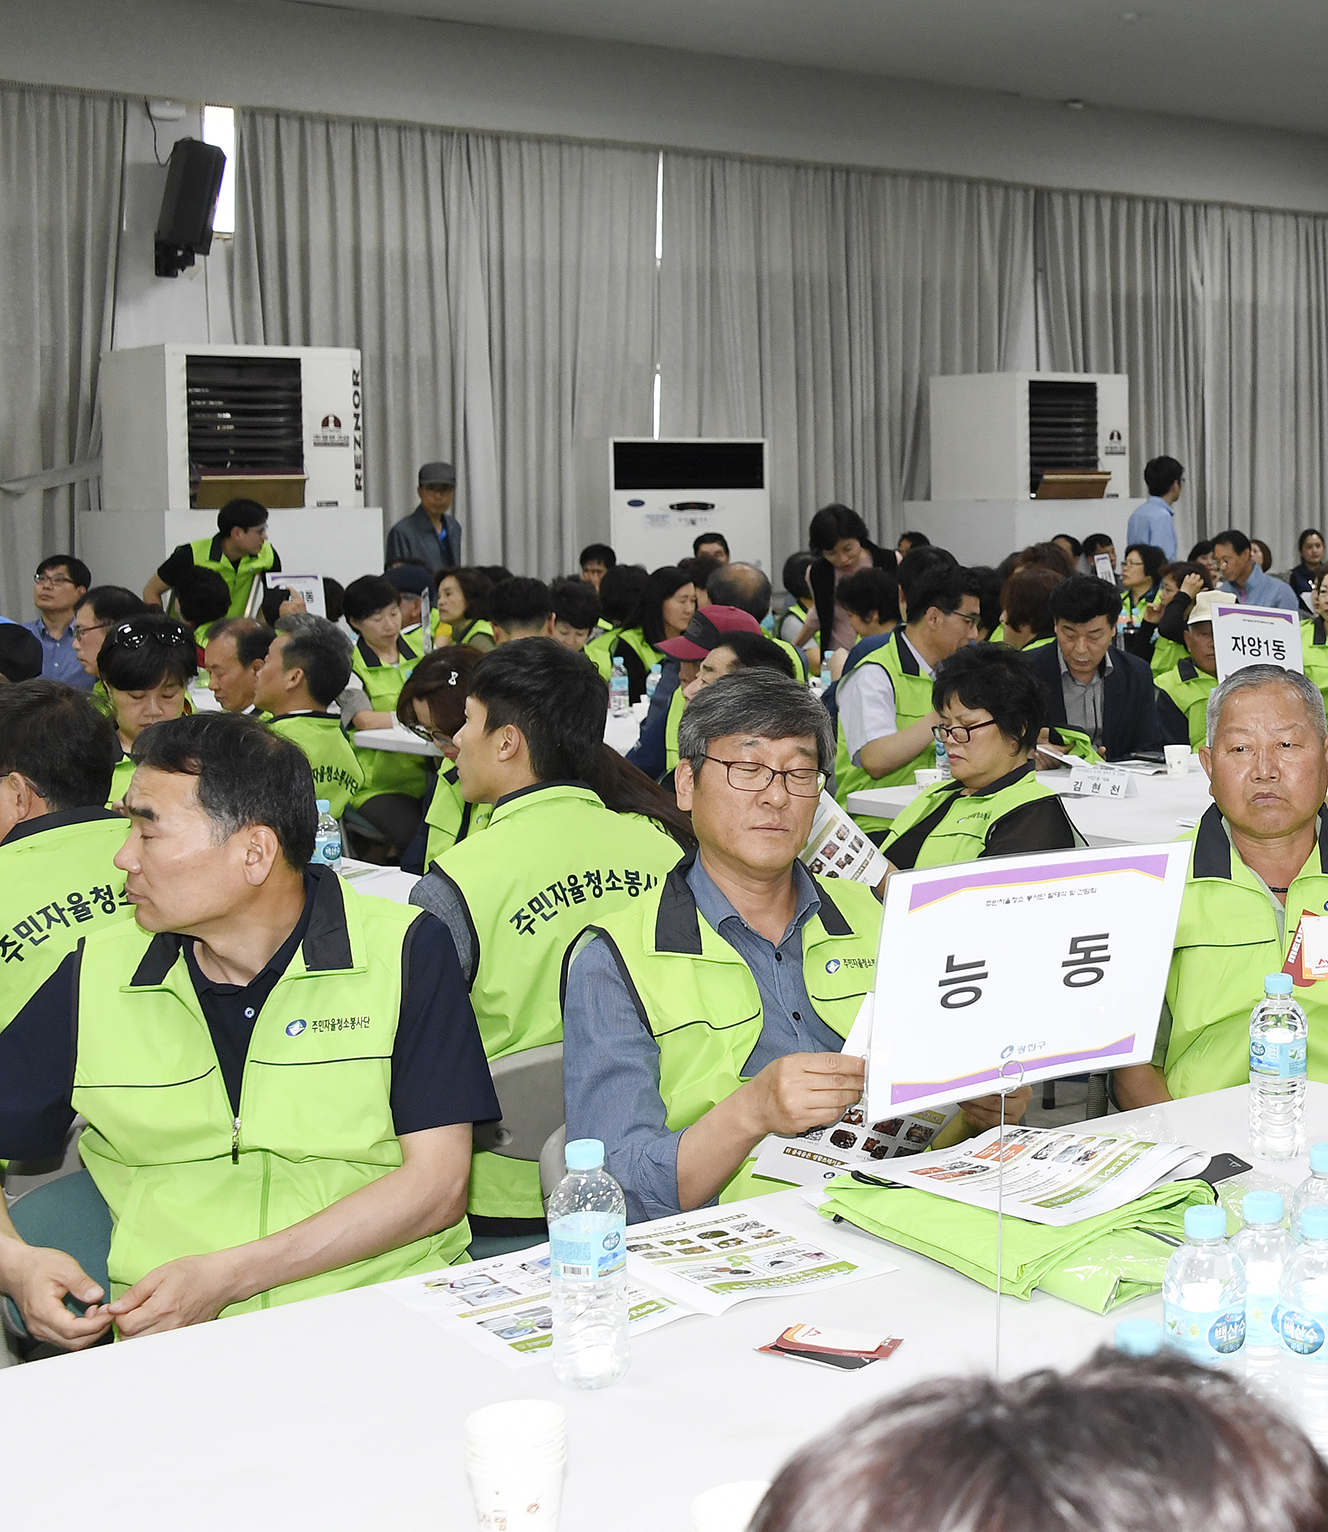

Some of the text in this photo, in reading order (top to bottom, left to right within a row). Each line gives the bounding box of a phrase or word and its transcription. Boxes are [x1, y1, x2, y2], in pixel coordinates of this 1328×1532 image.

[352, 369, 363, 491] REZNOR
[1231, 635, 1287, 661] 자양1동
[311, 1016, 371, 1034] 주민자율청소봉사단
[1214, 1319, 1246, 1341] 백산수
[1283, 1318, 1319, 1344] 백산수
